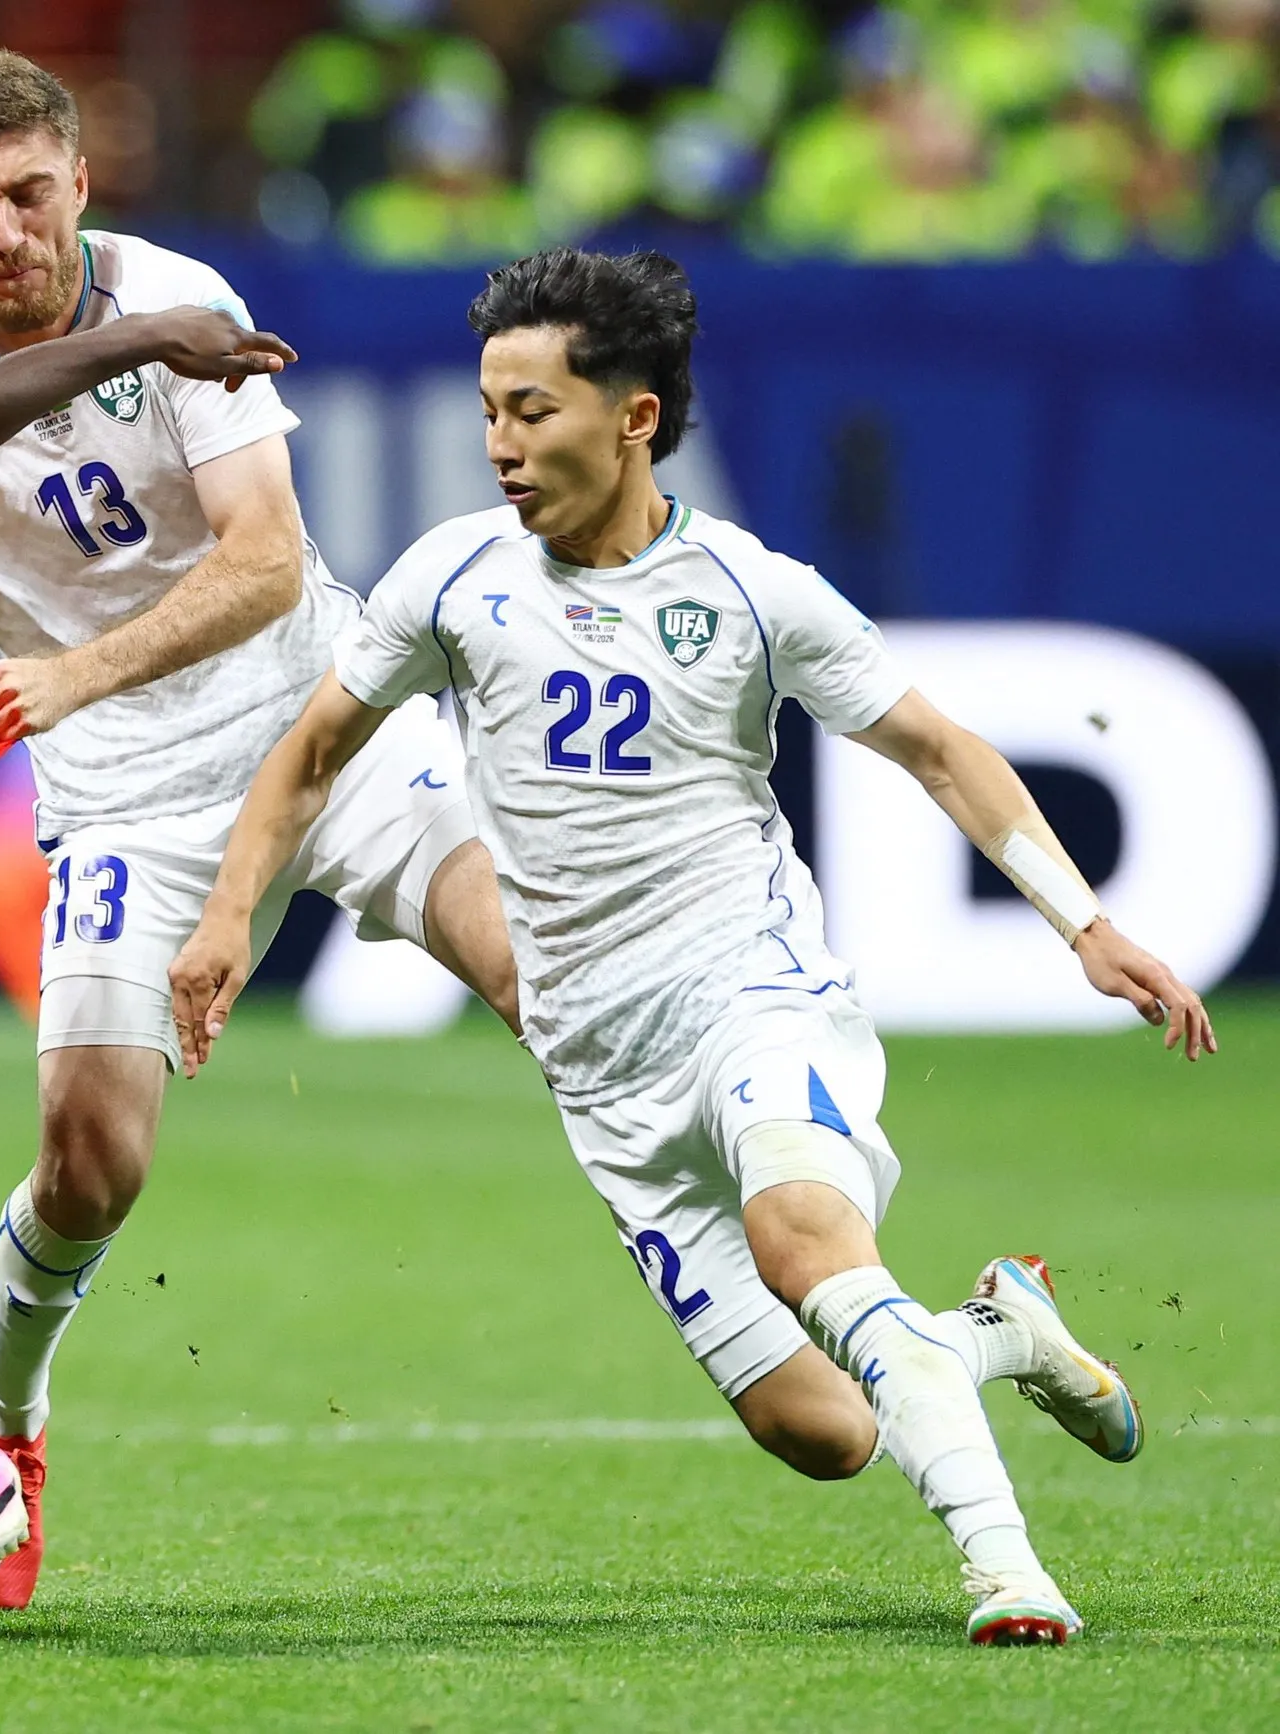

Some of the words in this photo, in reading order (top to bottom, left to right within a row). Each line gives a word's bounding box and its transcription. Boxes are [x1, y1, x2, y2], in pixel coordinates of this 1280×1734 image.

[34, 460, 148, 558] 13
[603, 624, 617, 634] USA
[665, 612, 710, 639] UFA
[541, 668, 652, 776] 22
[52, 854, 128, 950] 13
